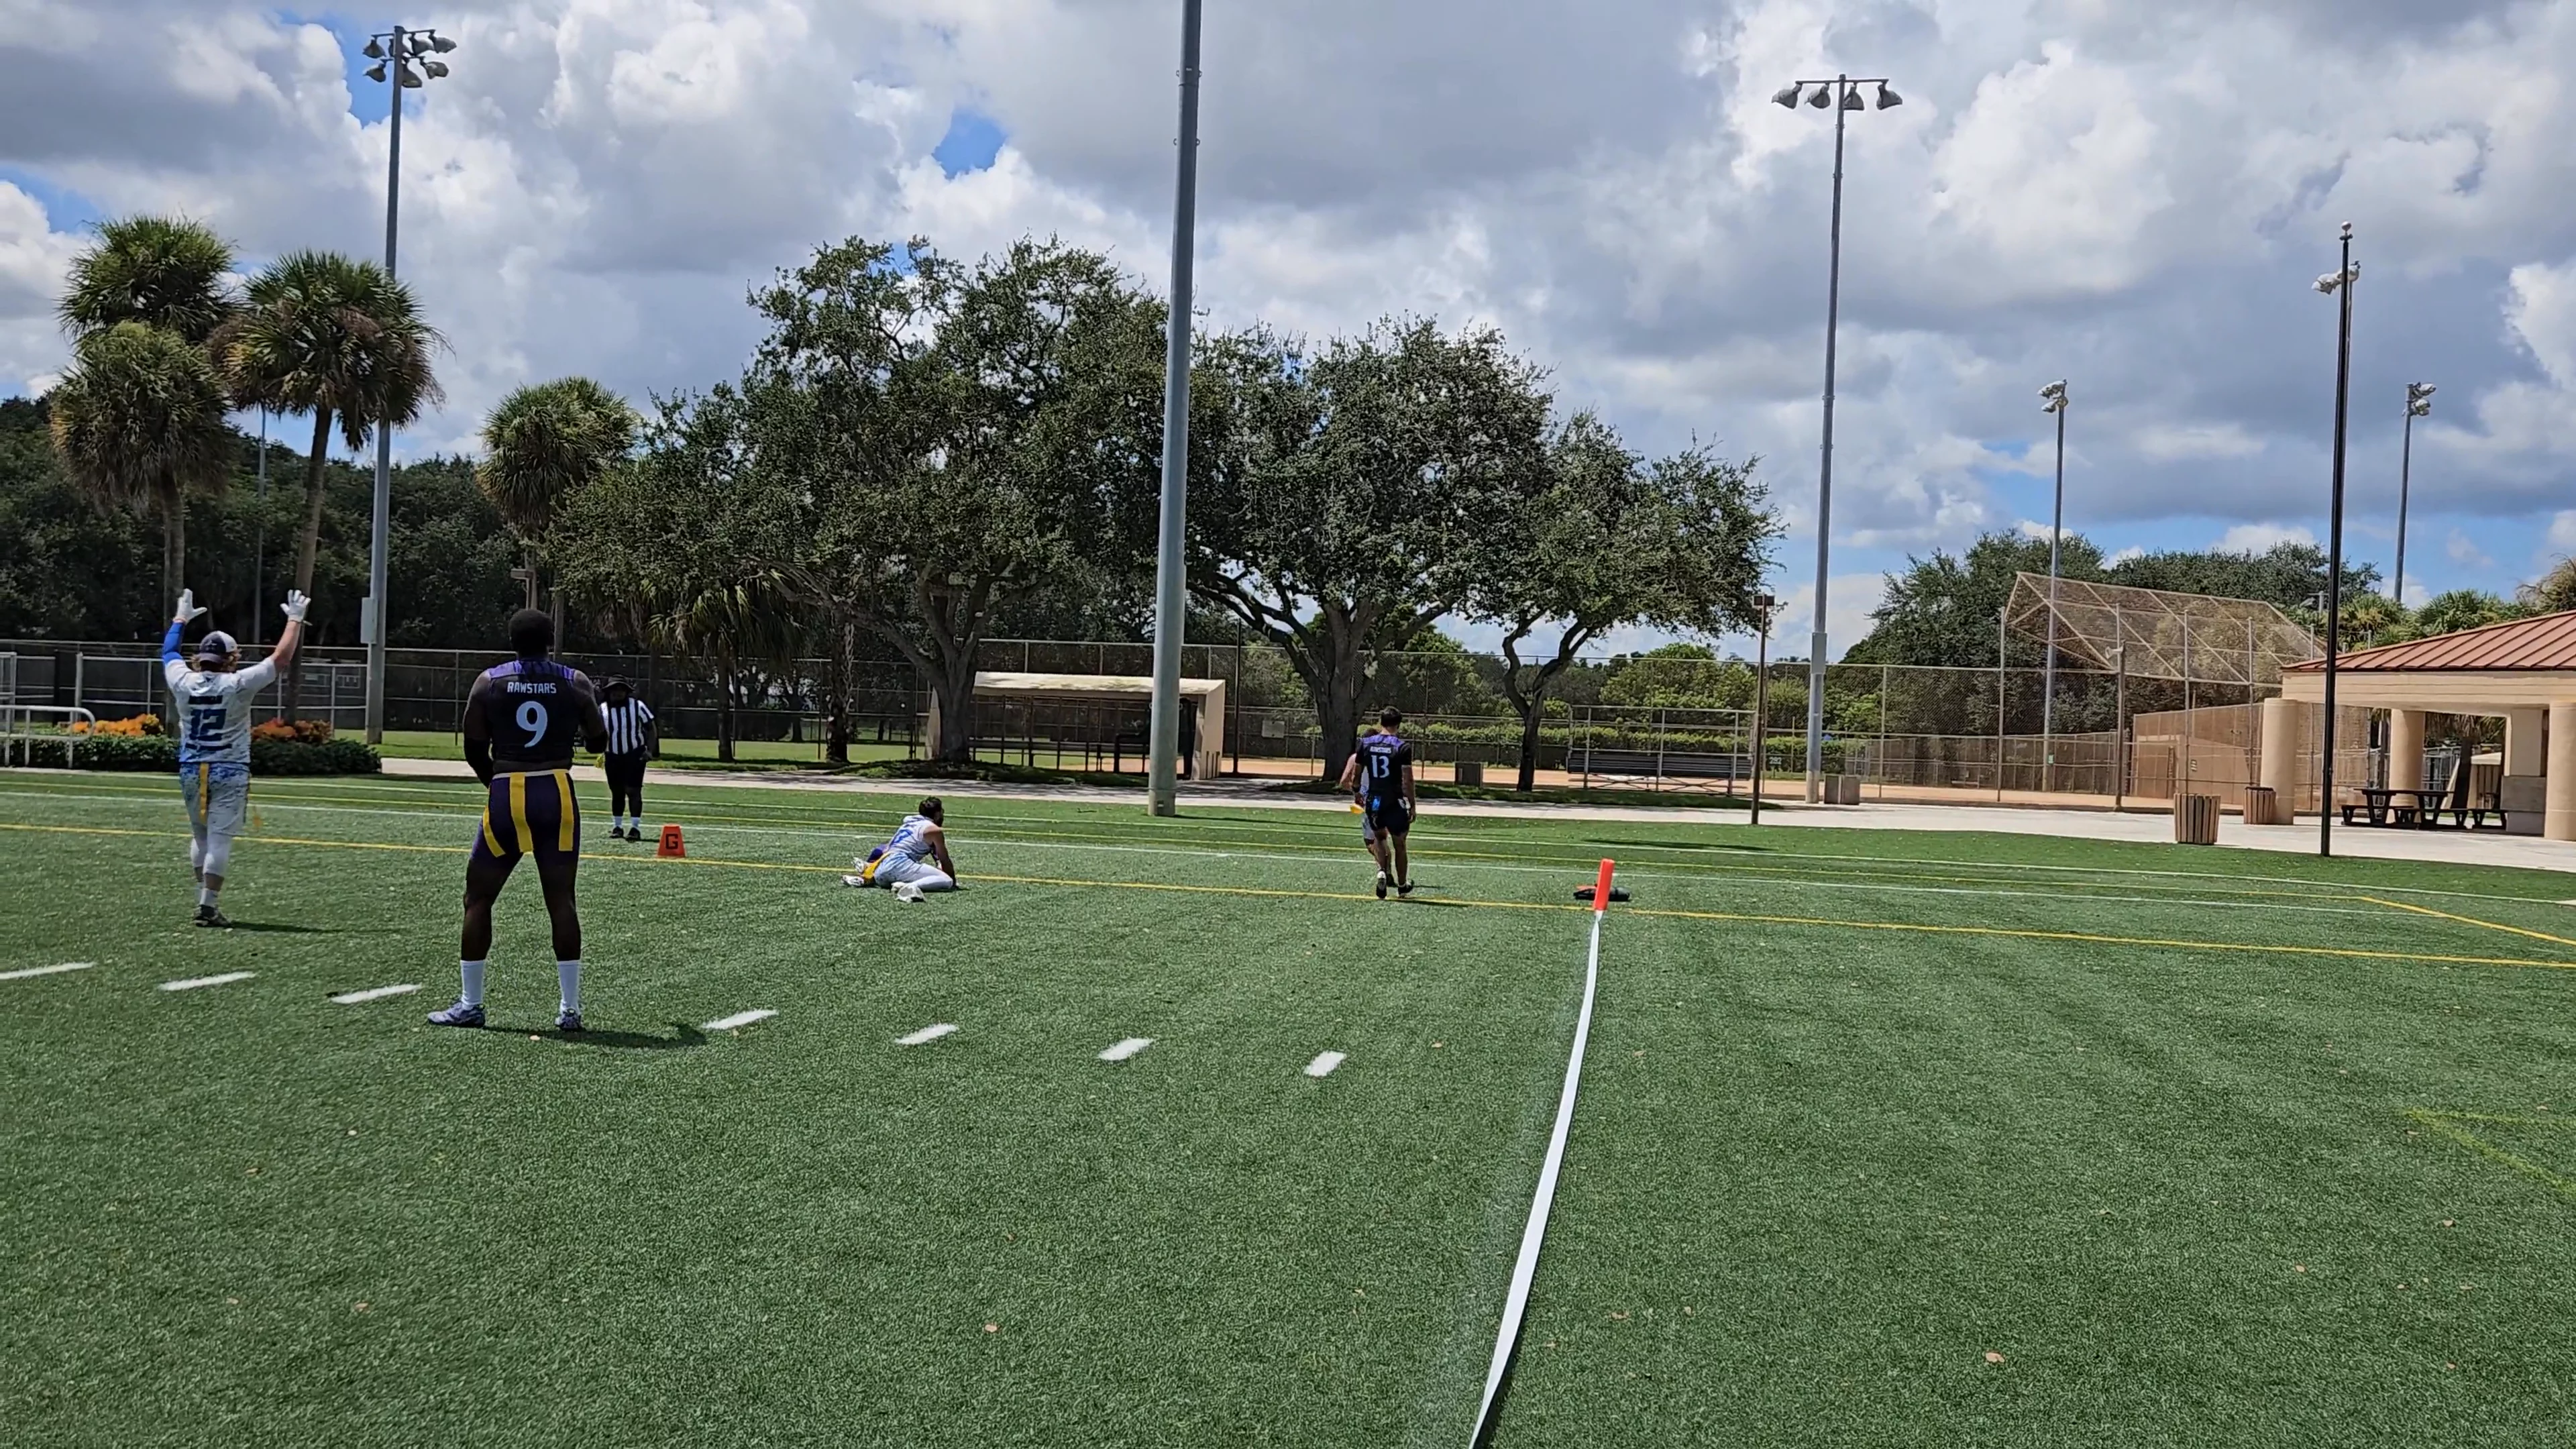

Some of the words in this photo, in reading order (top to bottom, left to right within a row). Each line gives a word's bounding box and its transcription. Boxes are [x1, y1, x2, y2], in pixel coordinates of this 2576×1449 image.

[507, 682, 557, 694] RAWSTARS
[189, 708, 227, 742] 12
[516, 700, 547, 748] 9
[1371, 755, 1390, 778] 13
[665, 833, 678, 849] G
